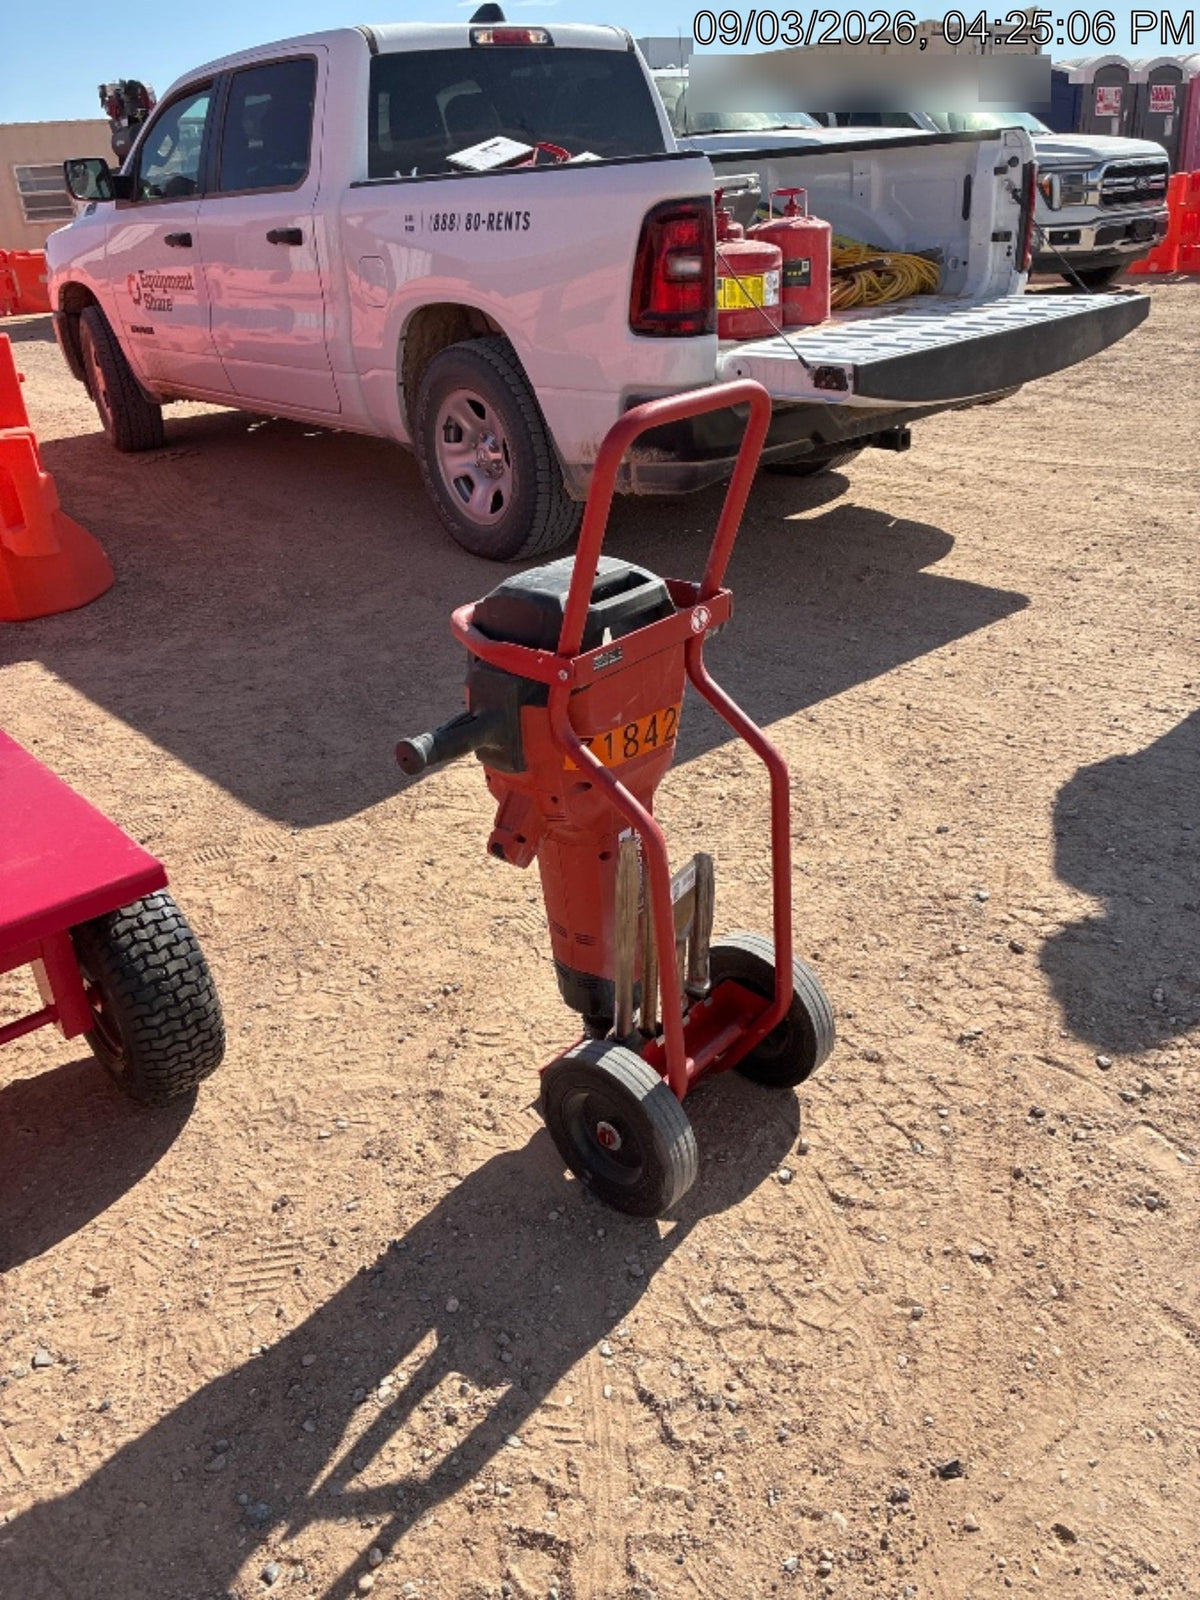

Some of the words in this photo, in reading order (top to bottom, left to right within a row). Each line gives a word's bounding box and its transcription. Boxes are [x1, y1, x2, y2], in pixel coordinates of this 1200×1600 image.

[429, 212, 460, 233] (888)
[465, 210, 531, 232] 80-RENTS
[138, 269, 194, 293] Equipment
[143, 293, 173, 312] Share
